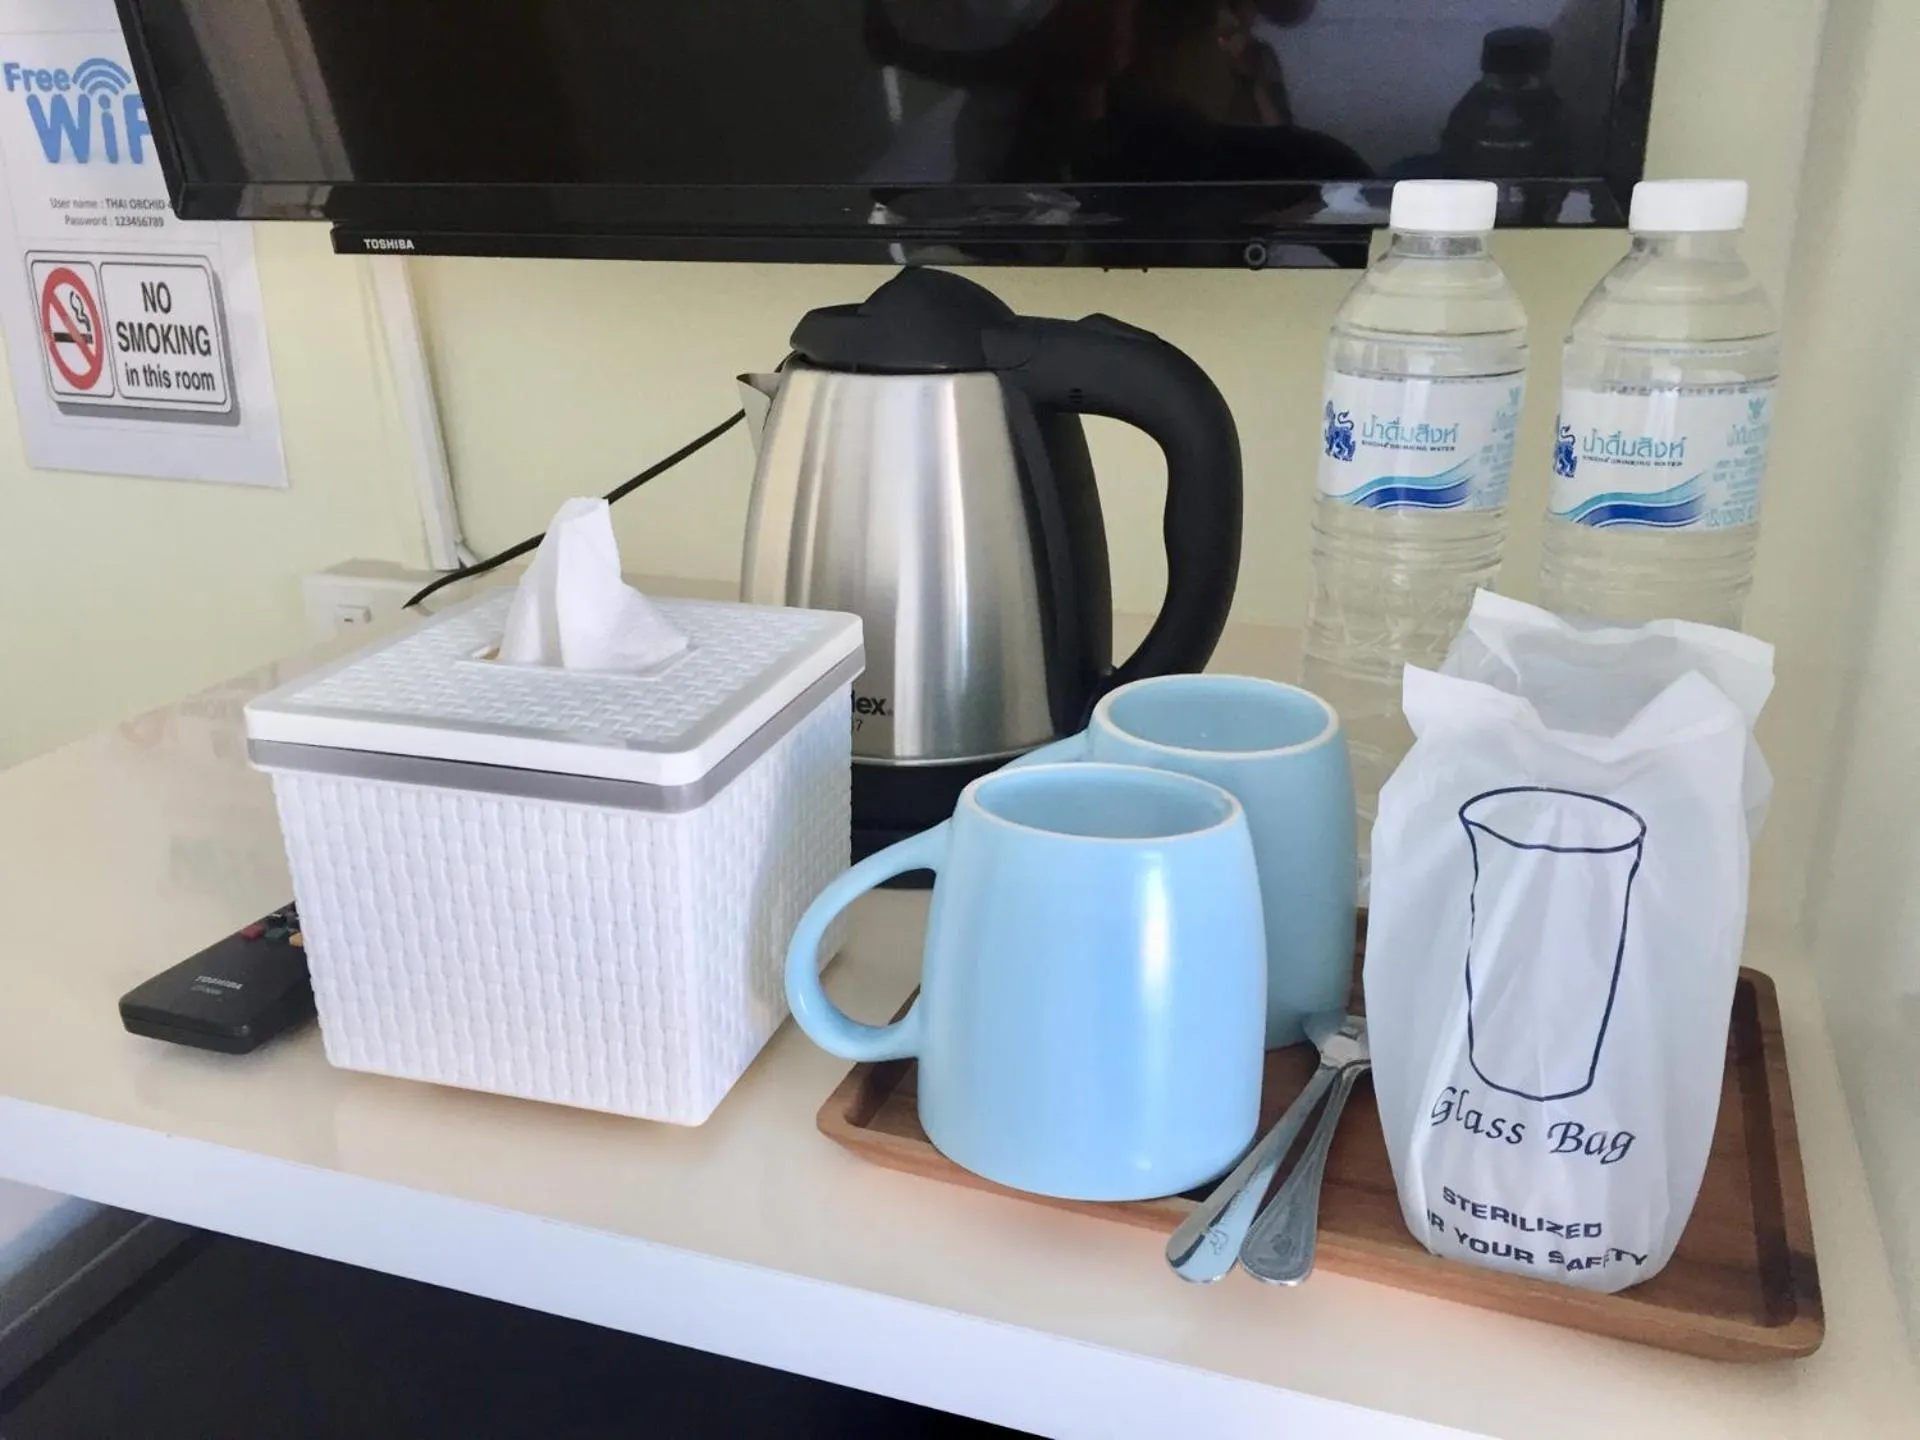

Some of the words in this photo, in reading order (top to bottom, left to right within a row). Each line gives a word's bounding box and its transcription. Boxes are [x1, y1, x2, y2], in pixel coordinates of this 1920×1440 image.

[3, 62, 71, 92] Free
[26, 94, 151, 164] WiF
[64, 214, 108, 226] Password
[105, 198, 127, 209] THAI
[130, 199, 165, 209] ORCHID
[363, 238, 415, 250] TOSHIBA
[141, 281, 172, 314] NO
[116, 321, 212, 357] SMOKING
[124, 362, 140, 387] in
[143, 363, 172, 389] this
[175, 371, 216, 392] room
[1431, 1085, 1526, 1145] Glass
[1547, 1121, 1637, 1165] Bag
[1442, 1185, 1603, 1240] STERILIZED
[1454, 1227, 1535, 1265] YOUR
